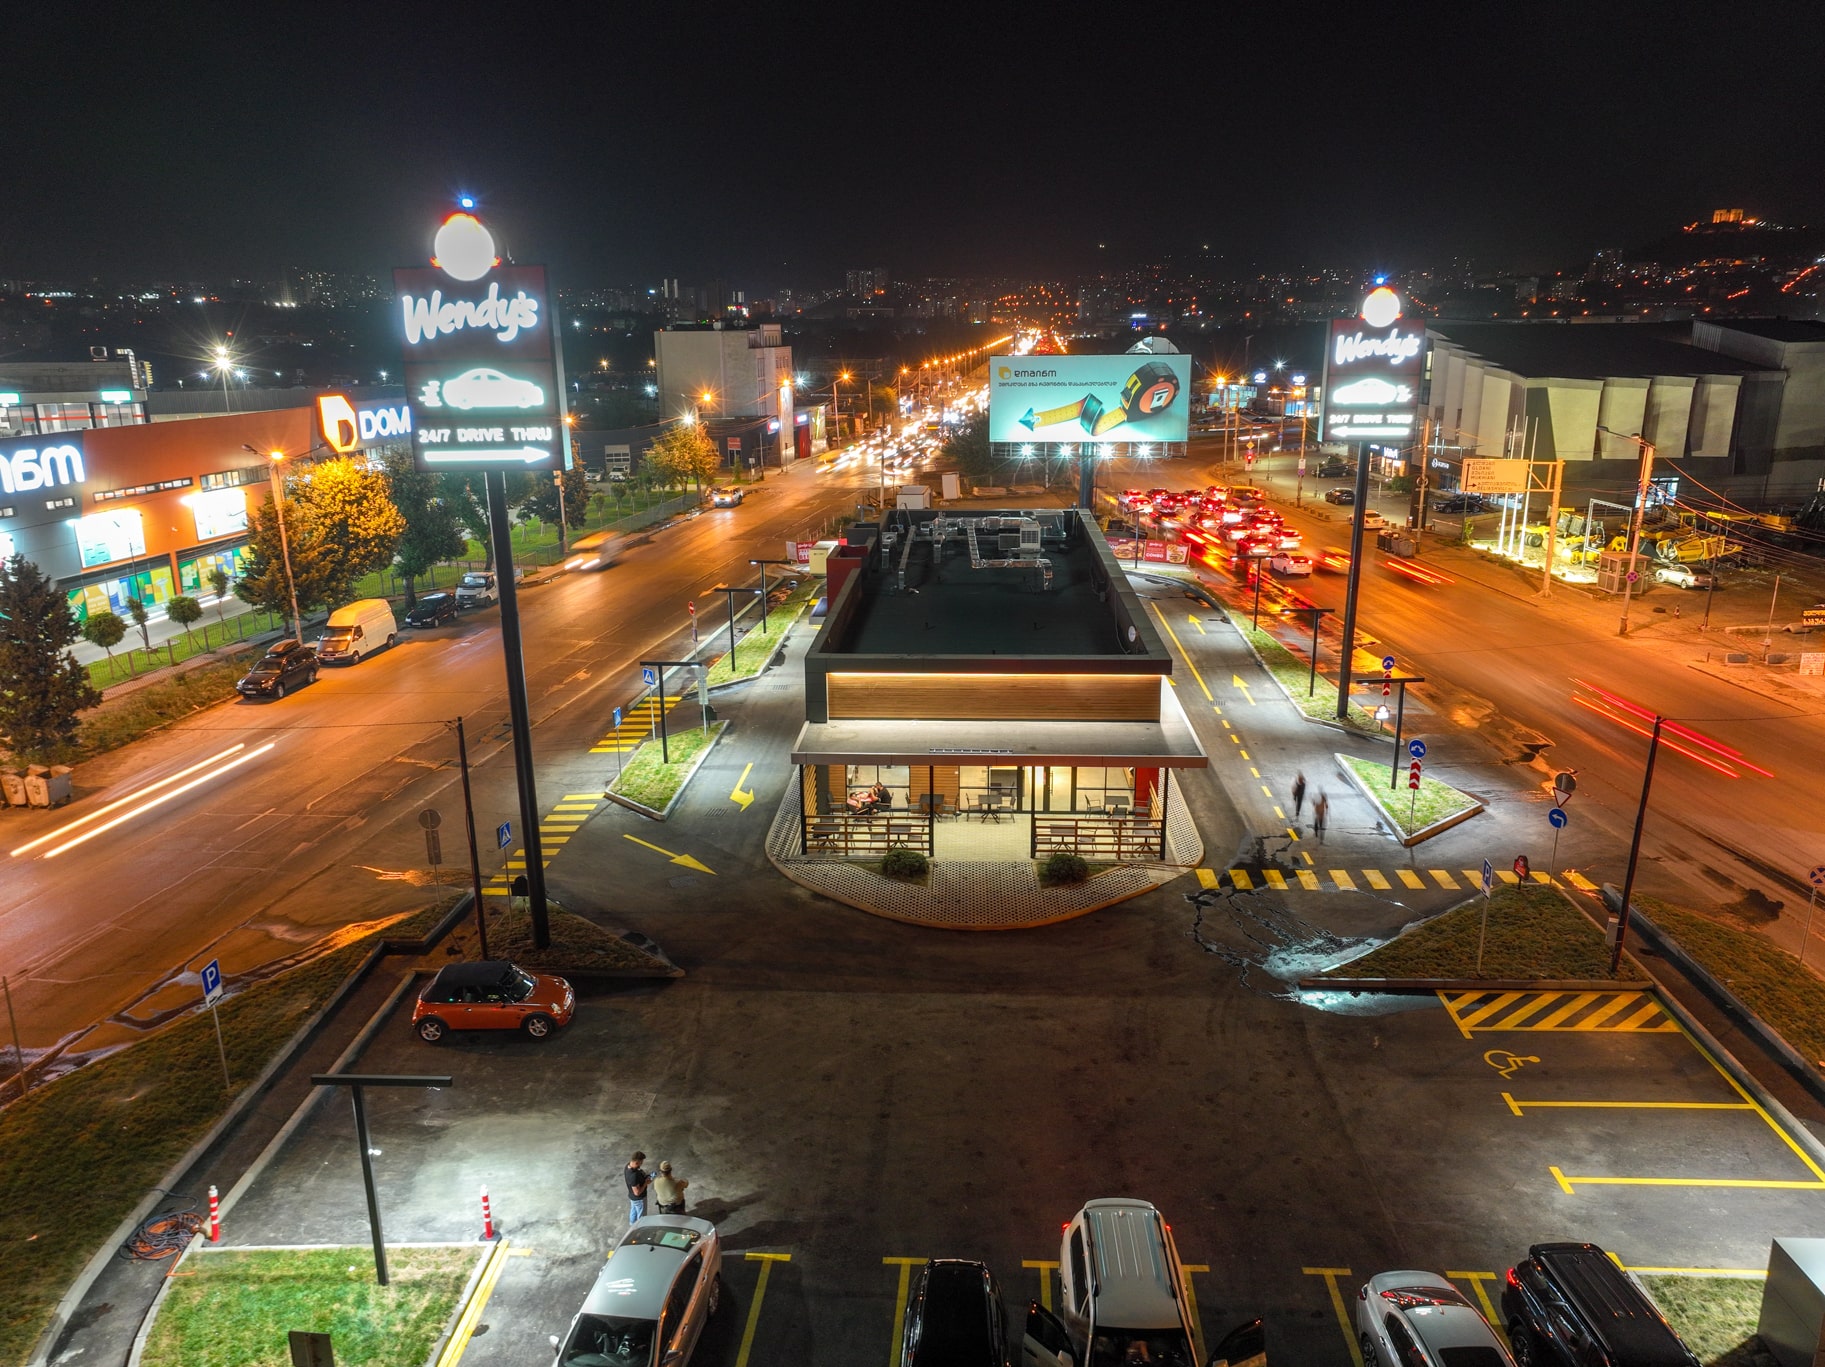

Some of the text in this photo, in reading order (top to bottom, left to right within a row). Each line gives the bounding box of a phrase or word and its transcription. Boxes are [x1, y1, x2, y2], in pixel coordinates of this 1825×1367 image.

[402, 282, 538, 344] Wendy's
[1335, 328, 1420, 365] Wendy's
[1353, 415, 1383, 424] DRIVE
[1386, 415, 1413, 424] THRU
[418, 427, 552, 443] 24/7 DRIVE THRU
[205, 966, 217, 990] P
